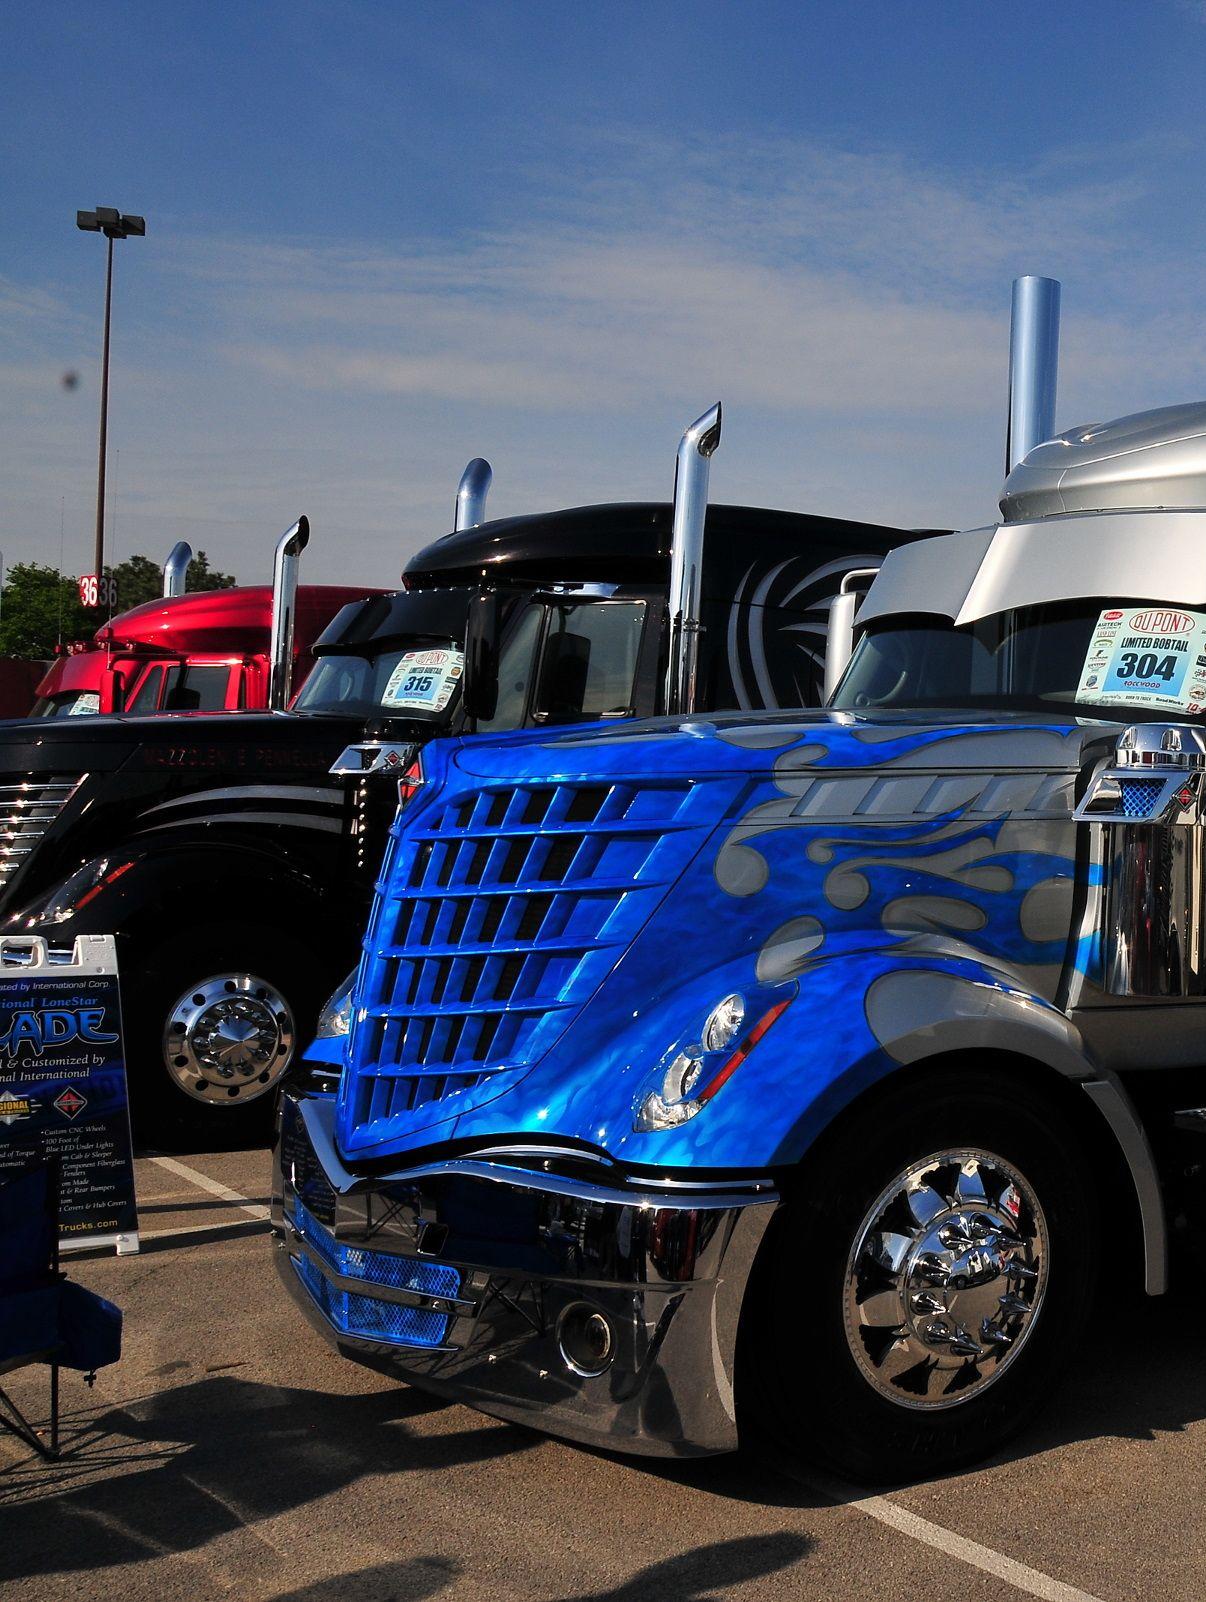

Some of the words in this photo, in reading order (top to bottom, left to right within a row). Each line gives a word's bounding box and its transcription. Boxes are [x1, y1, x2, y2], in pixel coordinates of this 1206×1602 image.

[82, 577, 98, 606] 36
[99, 577, 117, 607] 36
[1120, 637, 1154, 649] LIMITED
[1152, 637, 1189, 653] BOBTAIL
[1116, 652, 1178, 682] 304
[404, 676, 434, 692] 315
[20, 983, 31, 993] by
[33, 980, 87, 990] International
[41, 995, 99, 1008] LoneStar
[0, 1007, 119, 1058] ADE
[7, 1058, 19, 1069] &
[22, 1053, 89, 1068] Customized
[92, 1053, 106, 1067] by
[20, 1066, 90, 1082] International
[58, 1219, 119, 1232] Trucks.com
